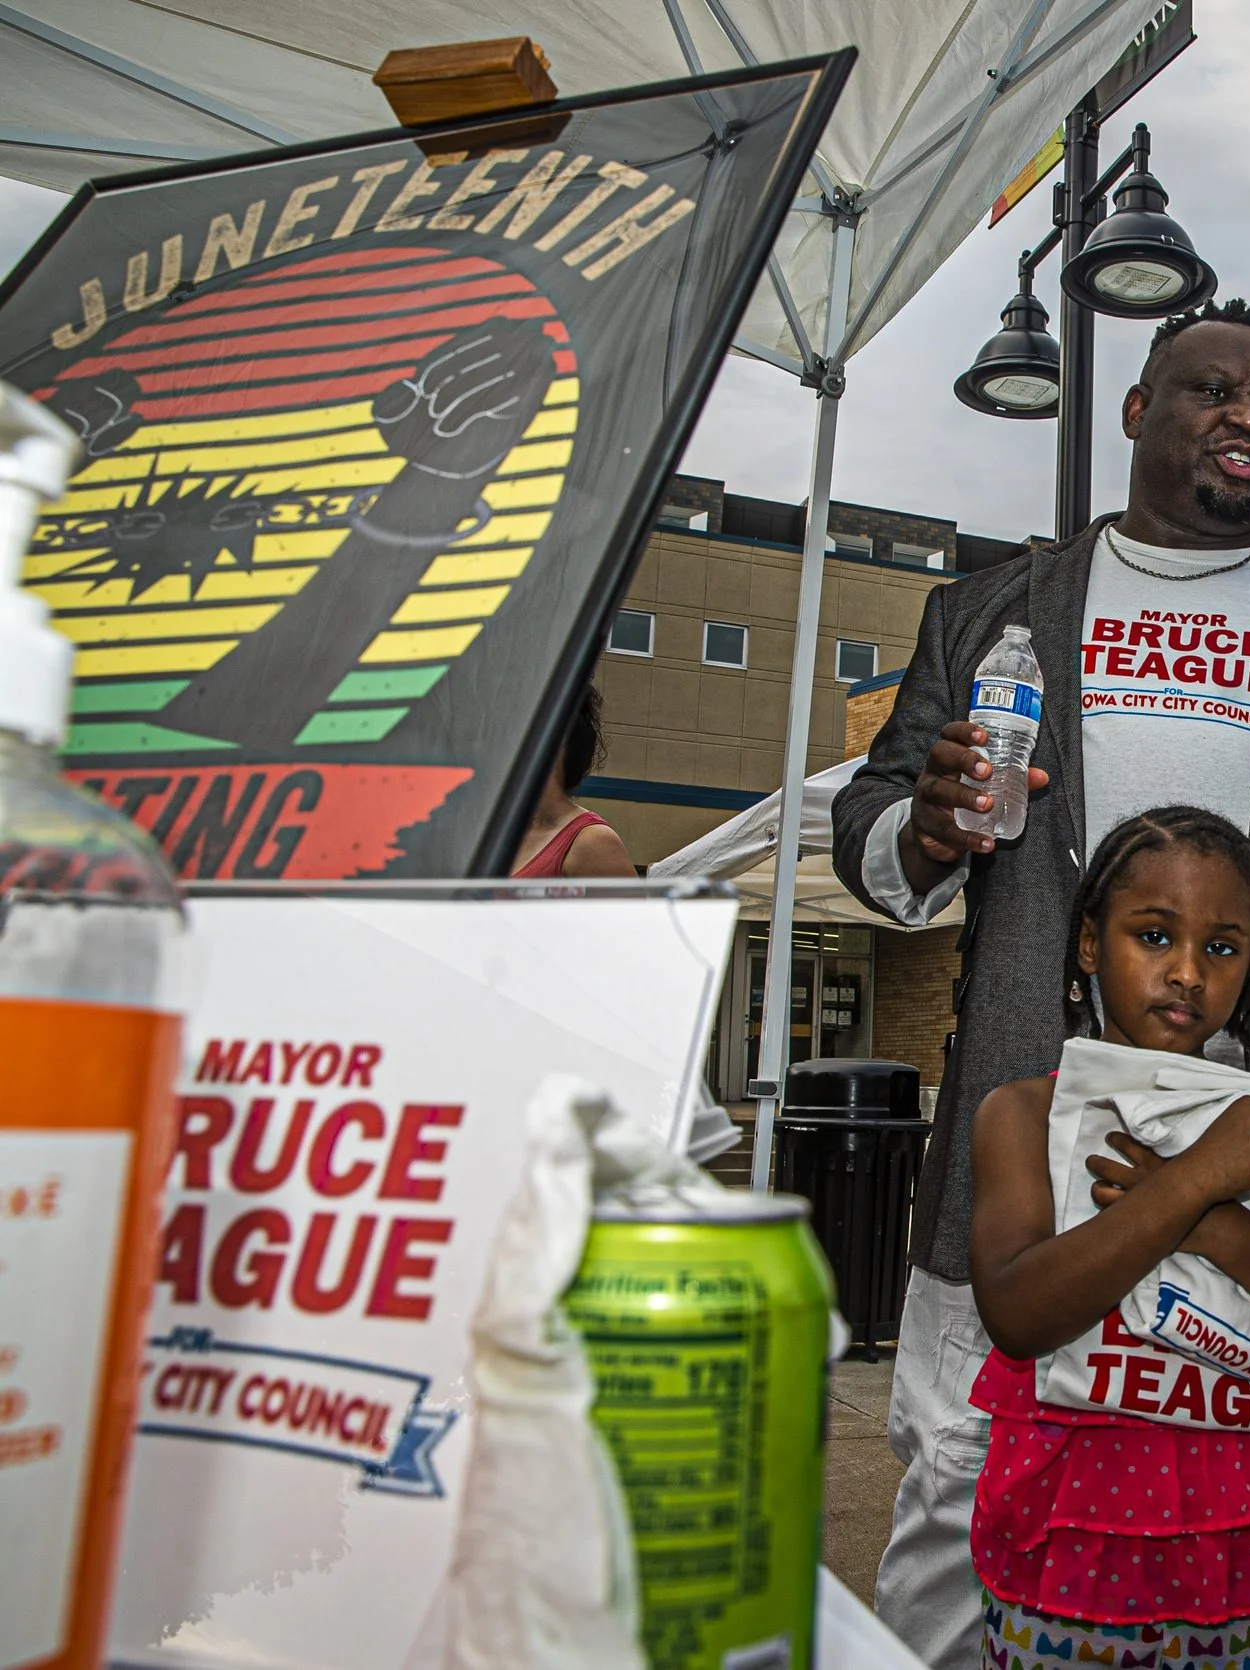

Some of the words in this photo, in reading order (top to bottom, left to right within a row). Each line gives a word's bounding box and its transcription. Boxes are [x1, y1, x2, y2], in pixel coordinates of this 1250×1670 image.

[52, 148, 696, 349] JUNETEENTH
[1140, 610, 1227, 627] MAYOR
[1082, 693, 1117, 709] OWA
[1122, 693, 1158, 709] CITY
[1162, 696, 1198, 711] CITY
[1164, 687, 1184, 696] FOR
[195, 1040, 382, 1088] MAYOR
[175, 1095, 466, 1202] RUCE
[157, 1203, 456, 1322] AGUE
[1175, 1307, 1249, 1367] COUNCIL
[153, 1363, 237, 1415] CITY
[237, 1372, 392, 1453] COUNCIL
